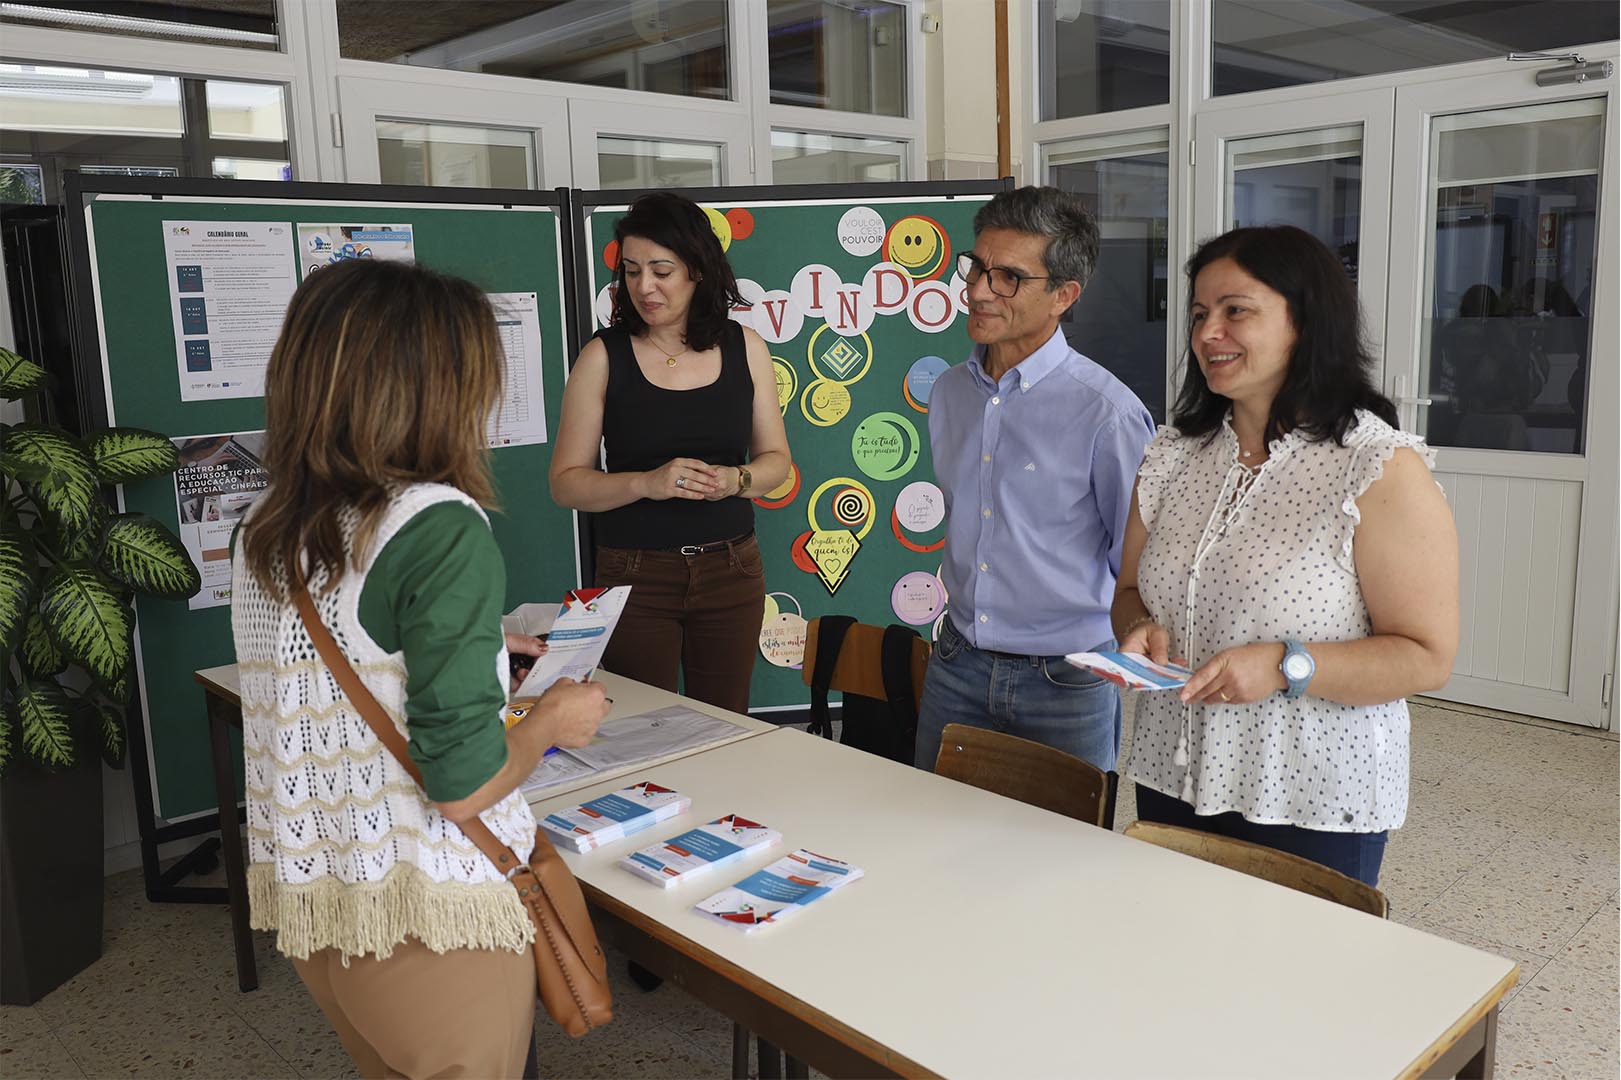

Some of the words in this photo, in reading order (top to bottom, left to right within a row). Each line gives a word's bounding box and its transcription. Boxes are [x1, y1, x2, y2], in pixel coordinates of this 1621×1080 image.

[845, 218, 882, 227] VOULOIR
[842, 235, 883, 244] POUVOIR
[857, 435, 868, 447] Tu
[177, 465, 214, 475] CENTRO
[216, 463, 228, 471] DE
[178, 471, 226, 482] RECURSOS
[228, 469, 242, 477] TIC
[181, 486, 223, 496] ESPECIAL
[231, 480, 268, 490] CINFÃES
[188, 476, 238, 488] EDUCAÇÃO
[814, 548, 838, 561] quem
[787, 635, 806, 647] mita
